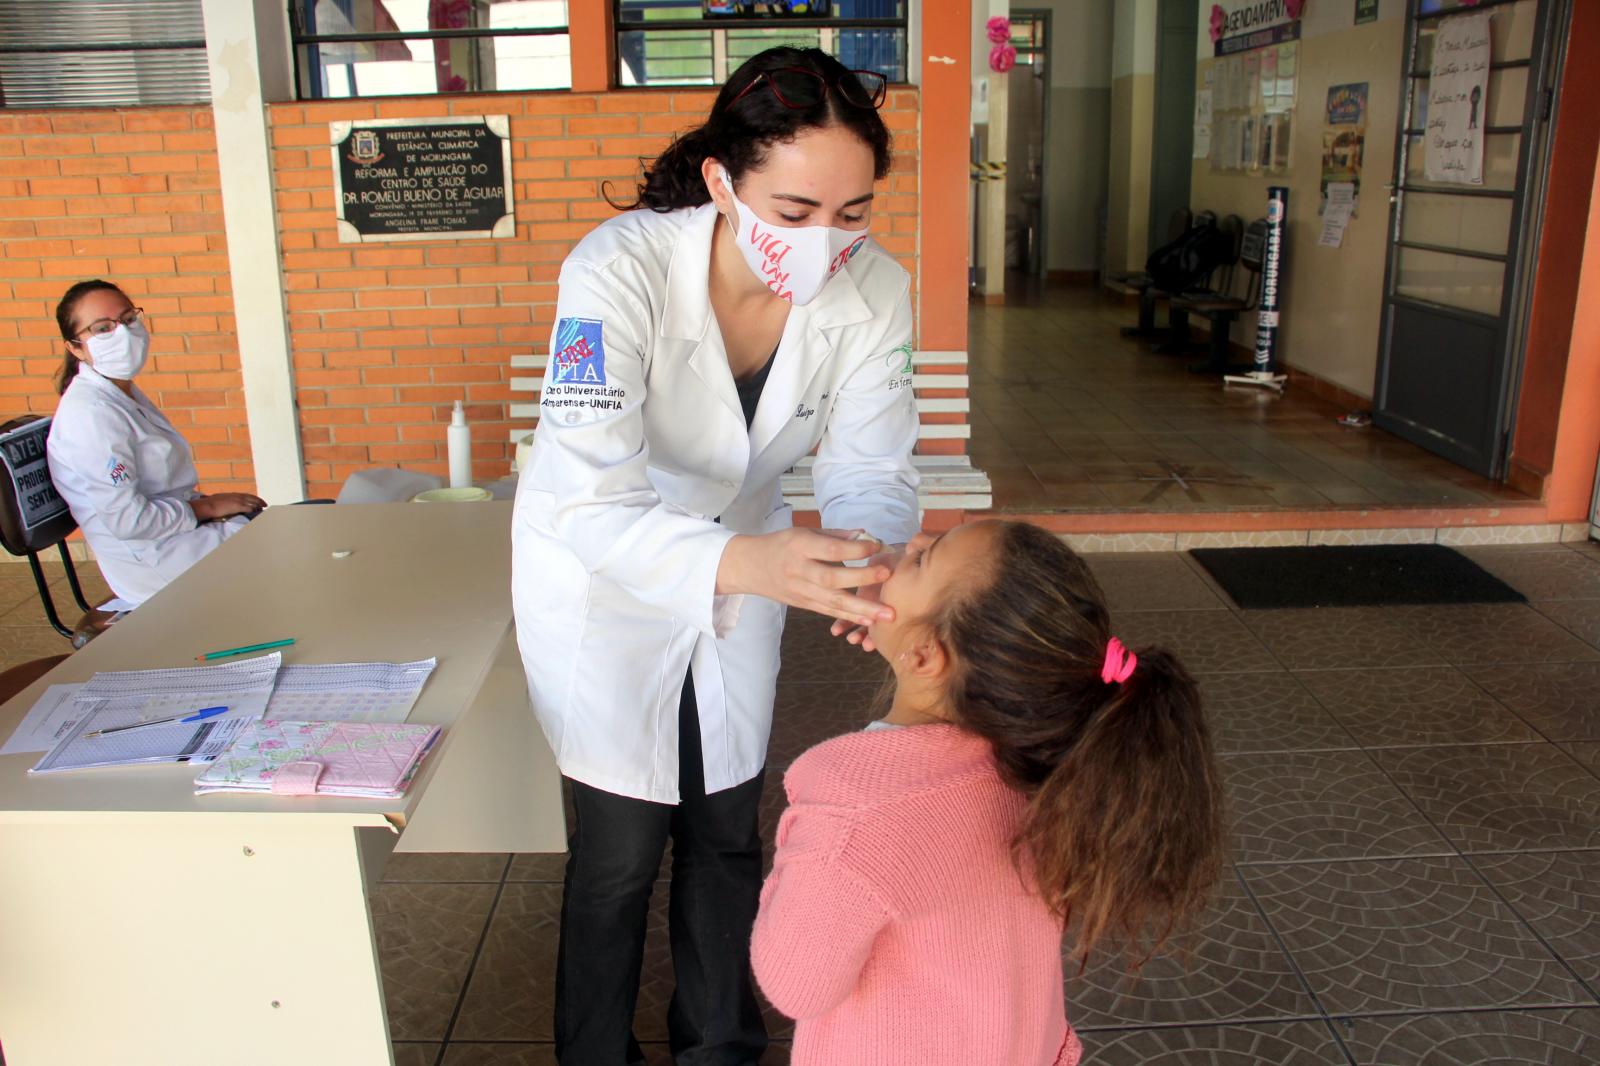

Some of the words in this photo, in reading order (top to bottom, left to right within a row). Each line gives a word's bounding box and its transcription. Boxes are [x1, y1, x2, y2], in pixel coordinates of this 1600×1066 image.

[386, 131, 427, 140] PREFEITURA
[431, 129, 471, 138] MUNICIPAL
[474, 128, 486, 137] DA
[397, 141, 433, 151] ESTÂNCIA
[406, 154, 416, 162] DE
[420, 152, 472, 161] MORUNGABA
[355, 168, 398, 180] REFORMA
[471, 163, 488, 175] DO
[381, 178, 418, 189] CENTRO
[422, 177, 433, 187] DE
[343, 191, 359, 204] DR.
[361, 190, 401, 204] ROMEU
[403, 188, 441, 202] BUENO
[445, 188, 458, 200] DE
[463, 186, 504, 200] AGUIAR
[1264, 226, 1282, 307] MORUNGABA
[564, 385, 626, 398] Universitário
